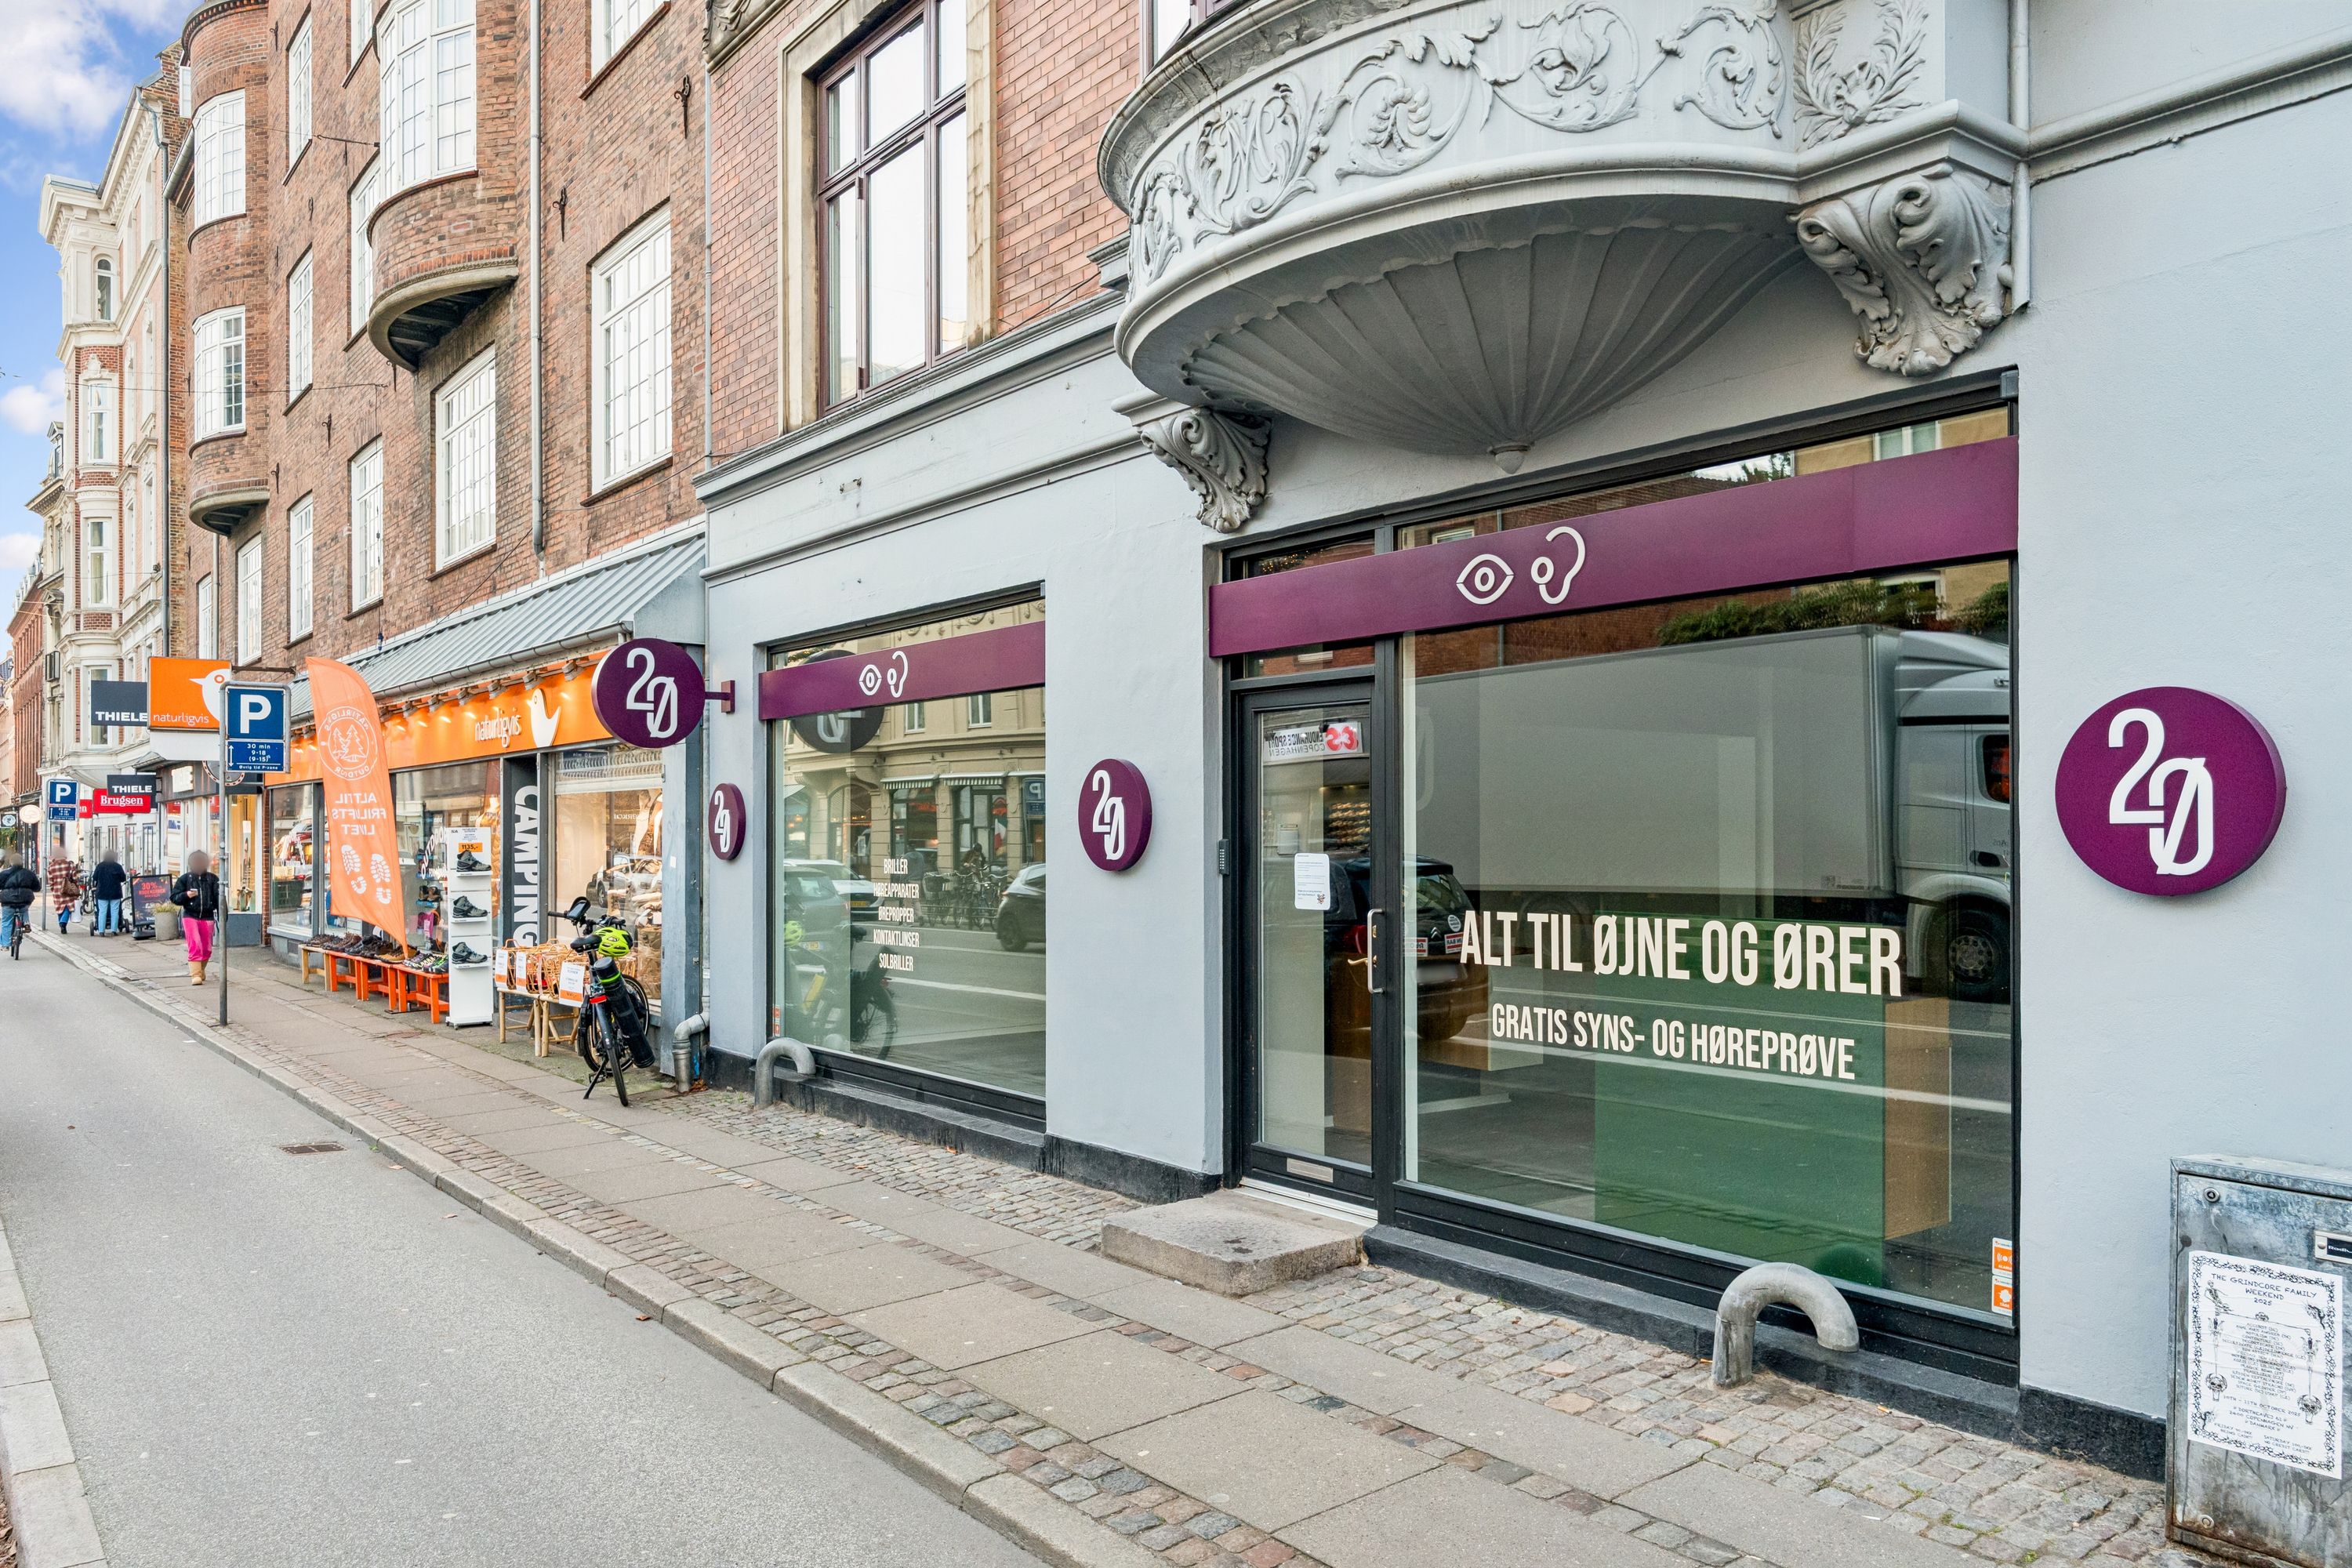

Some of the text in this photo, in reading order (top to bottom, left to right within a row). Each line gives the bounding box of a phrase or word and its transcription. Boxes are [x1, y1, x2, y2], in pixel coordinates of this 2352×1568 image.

[95, 711, 148, 722] THIELE
[153, 712, 209, 726] naturligvis
[240, 694, 271, 734] P
[474, 707, 523, 748] naturligvis
[56, 784, 71, 802] P
[100, 796, 143, 806] Brugsen
[514, 785, 538, 949] CAMPING
[884, 858, 908, 874] BRILLER
[873, 883, 920, 898] HØREAPPARATER
[879, 906, 914, 923] ØREPROPPER
[873, 929, 920, 948] KONTAKTLINSER
[879, 953, 913, 971] SOLBRILLER
[1460, 910, 1901, 996] ALT TIL ØJNE OG ØRER
[1492, 1003, 1855, 1080] GRATIS SYNS- OG HØREPRØVE
[2211, 1272, 2316, 1298] THE GRINDCORE FAMILY
[2245, 1287, 2284, 1300] WEEKEND
[2253, 1297, 2271, 1305] 2025
